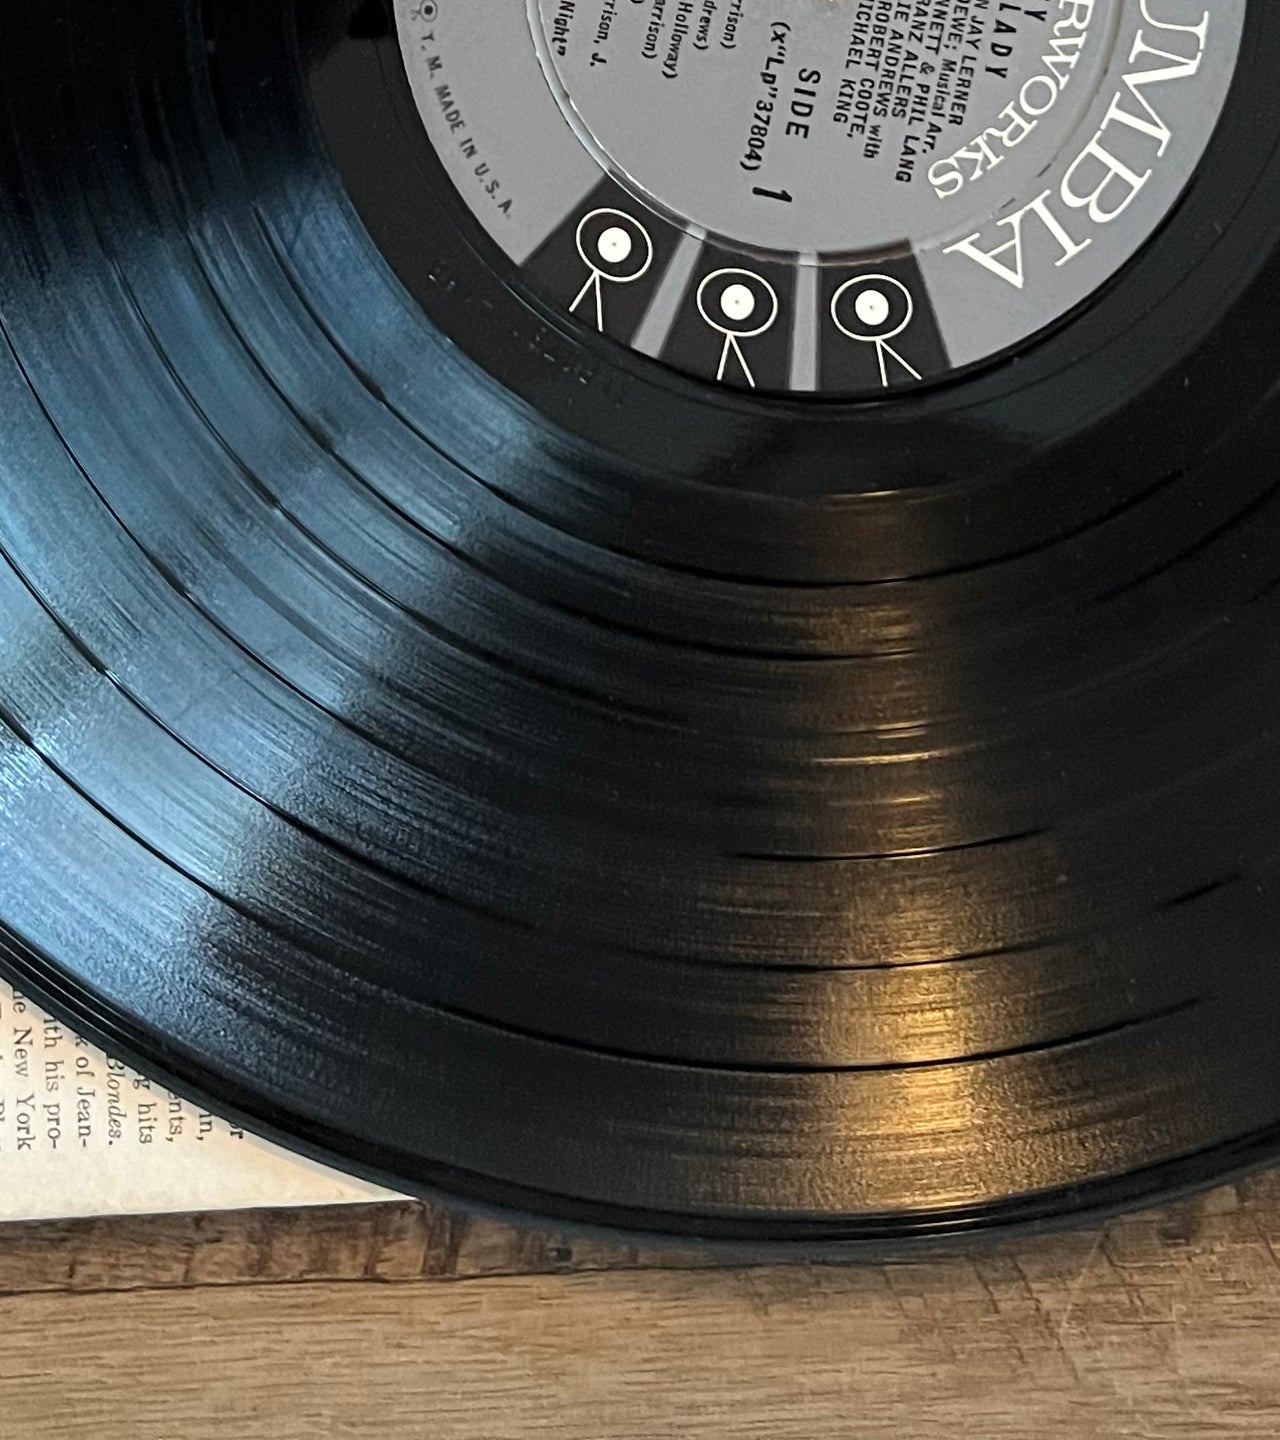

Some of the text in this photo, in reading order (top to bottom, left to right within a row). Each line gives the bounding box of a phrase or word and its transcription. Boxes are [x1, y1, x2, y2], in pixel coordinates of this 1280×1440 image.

[661, 1, 694, 79] Holloway)
[865, 0, 893, 72] ROBERT
[966, 15, 985, 50] JAY
[985, 2, 1022, 78] LADY
[873, 28, 905, 118] ANDREWS
[919, 61, 936, 75] &
[931, 58, 957, 118] Musical
[948, 54, 977, 125] LERNER
[435, 85, 466, 134] MADE
[460, 138, 478, 158] IN
[785, 68, 821, 139] SIDE
[833, 78, 857, 123] KING
[847, 78, 875, 138] COOTE,
[908, 83, 931, 125] PHIL
[863, 124, 883, 158] with
[895, 134, 921, 183] LANG
[922, 121, 943, 154] Arr.
[752, 186, 793, 203] 1
